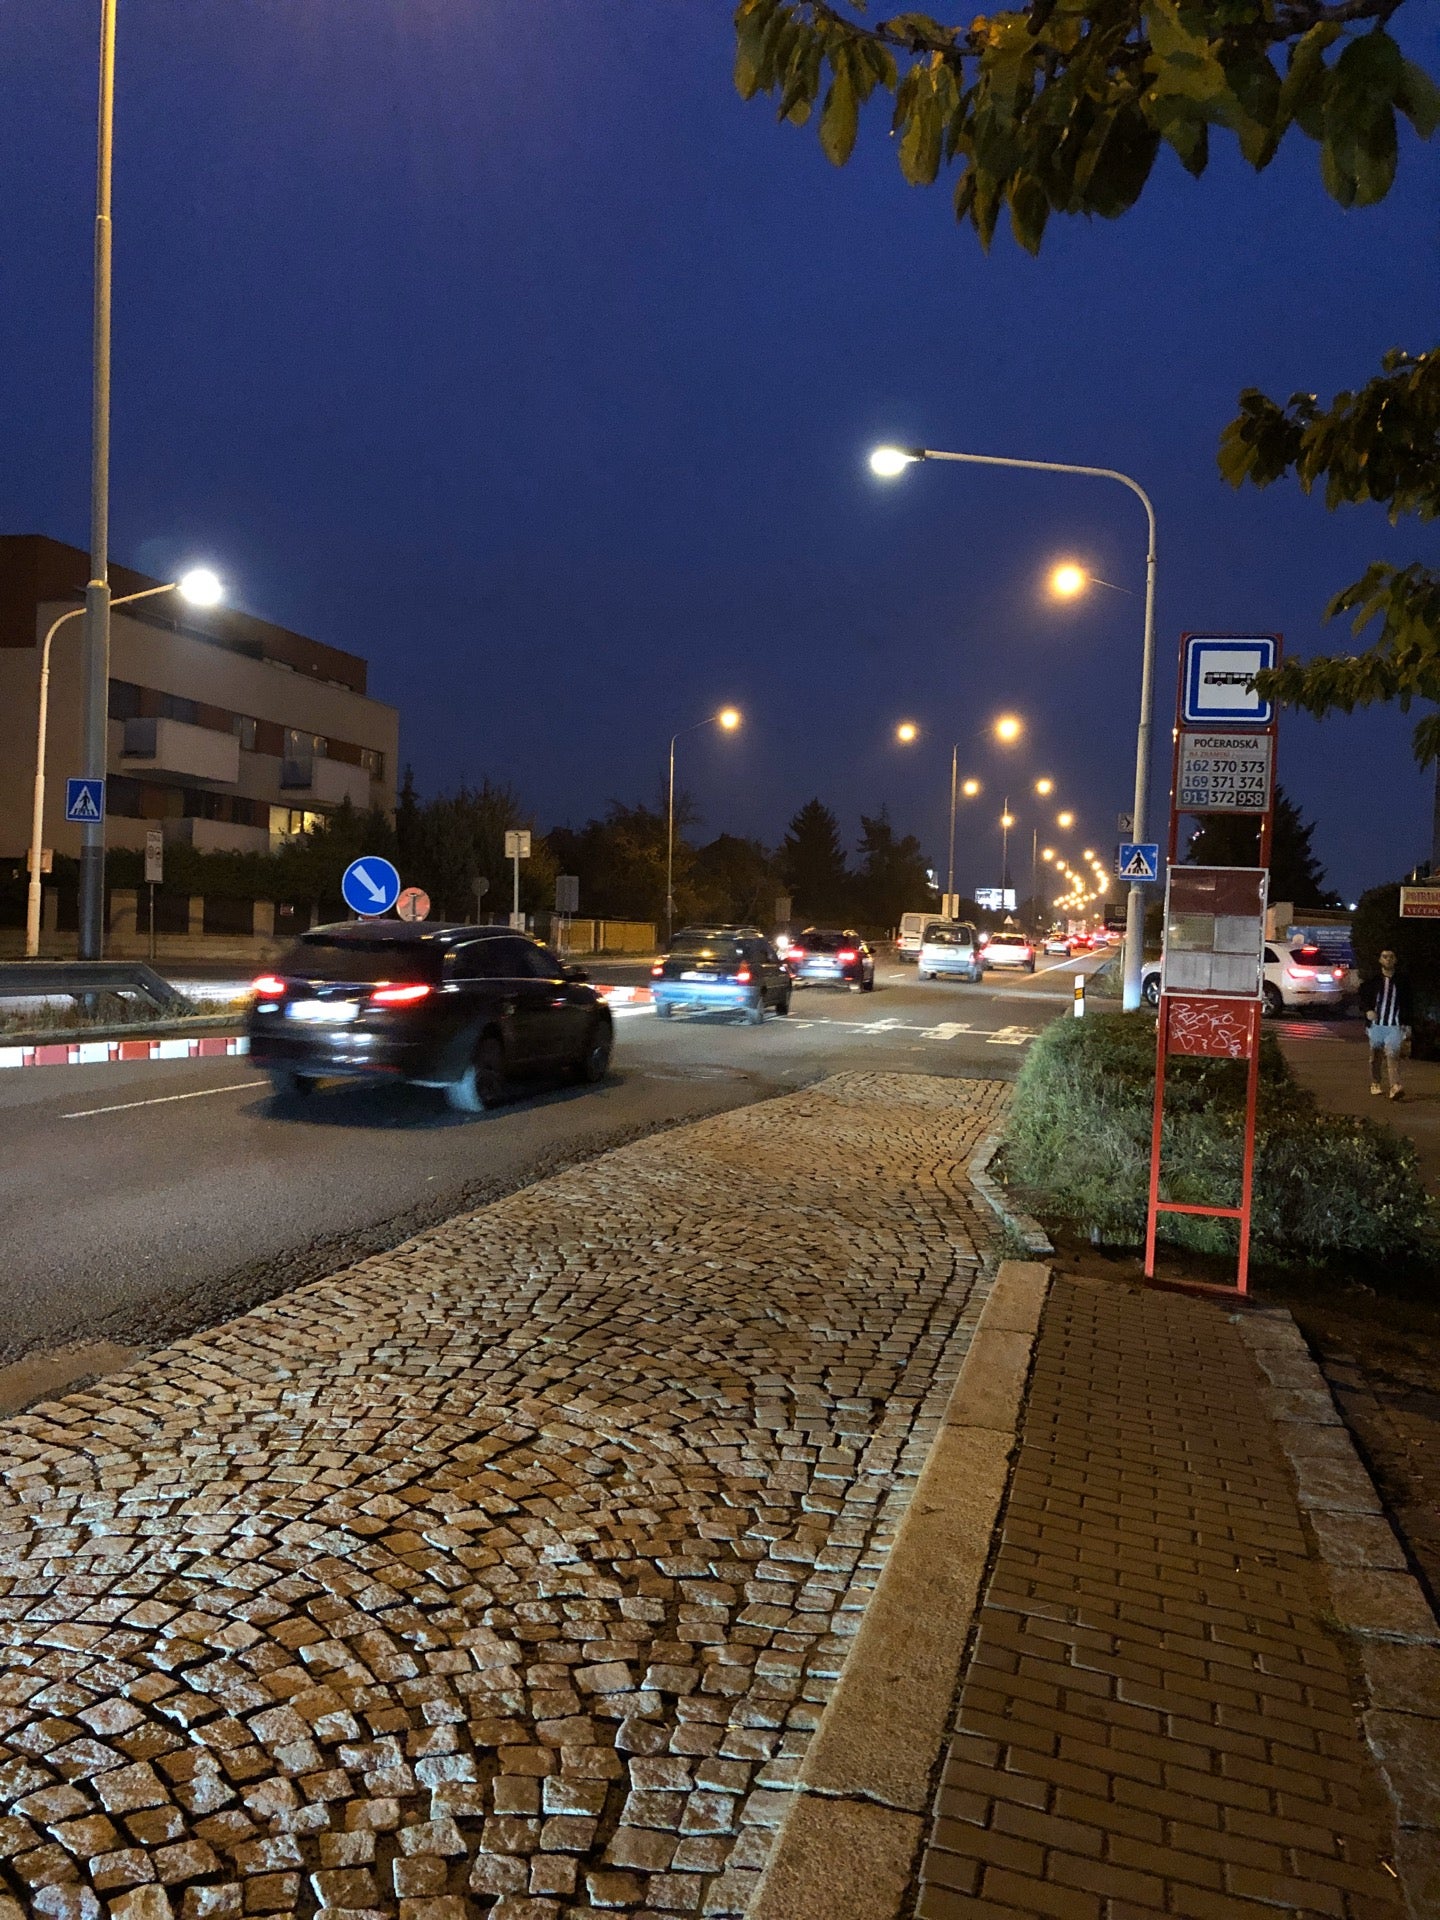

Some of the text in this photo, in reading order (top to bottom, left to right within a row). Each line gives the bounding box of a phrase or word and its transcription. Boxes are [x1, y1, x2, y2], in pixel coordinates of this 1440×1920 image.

[1194, 737, 1258, 749] POČERADSKÁ
[1185, 760, 1265, 774] 162 370 373
[1184, 776, 1264, 789] 169 371 374
[1183, 790, 1263, 806] 913 372 958
